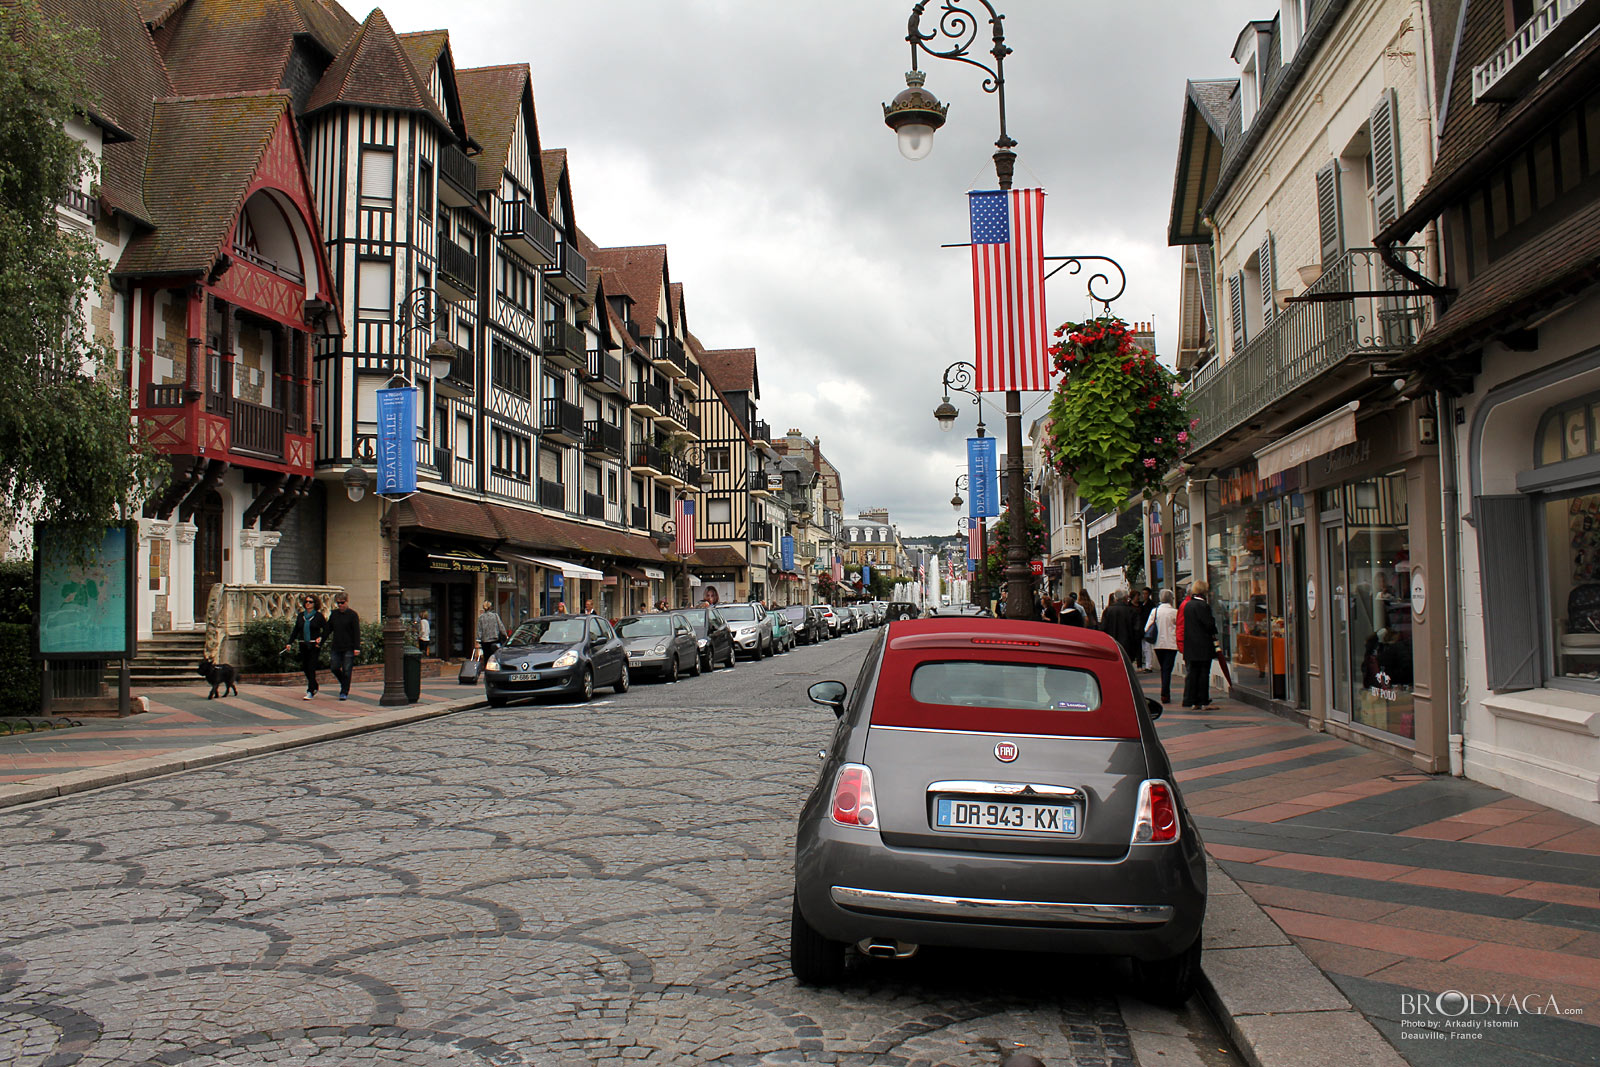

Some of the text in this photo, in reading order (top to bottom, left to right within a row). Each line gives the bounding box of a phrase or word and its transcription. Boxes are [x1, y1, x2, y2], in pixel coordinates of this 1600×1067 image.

[384, 412, 397, 489] DEAUVILLE
[973, 456, 985, 514] DEAUVILLE
[1031, 564, 1042, 572] FR
[1380, 688, 1397, 702] POLO
[1000, 746, 1014, 757] FIAT
[956, 803, 1059, 829] DR-943-KX
[1063, 821, 1074, 832] 14
